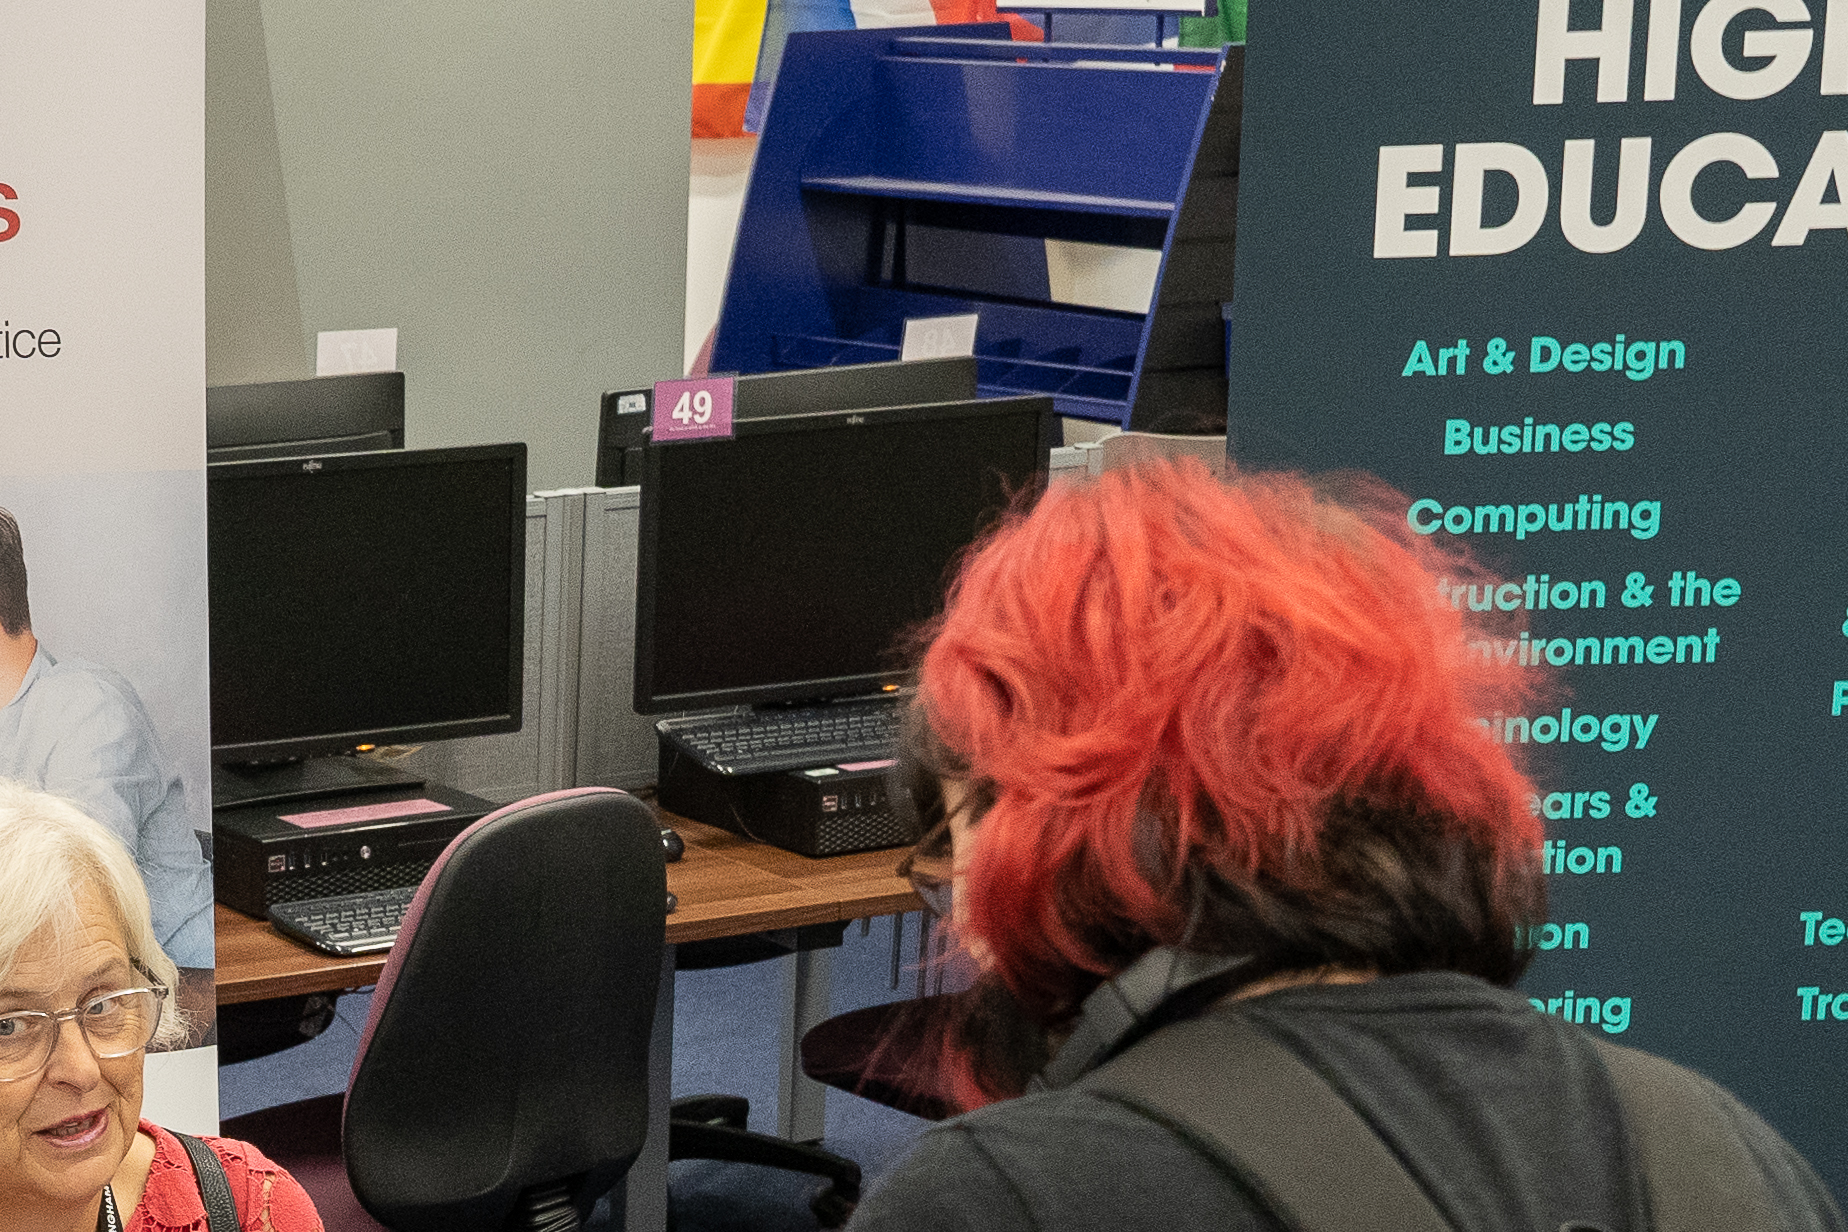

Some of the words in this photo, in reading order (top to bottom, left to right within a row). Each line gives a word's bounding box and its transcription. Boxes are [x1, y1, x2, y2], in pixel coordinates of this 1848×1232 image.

[1533, 0, 1848, 105] HIG
[1402, 339, 1470, 377] Art
[1483, 337, 1516, 375] &
[1529, 334, 1686, 381] Design
[672, 390, 713, 426] 49
[1444, 417, 1635, 455] Business
[1407, 495, 1662, 541] Computing
[1621, 571, 1654, 609] &
[1669, 571, 1741, 607] the
[1479, 709, 1659, 751] inology
[1625, 782, 1658, 819] &
[1800, 911, 1848, 946] Te
